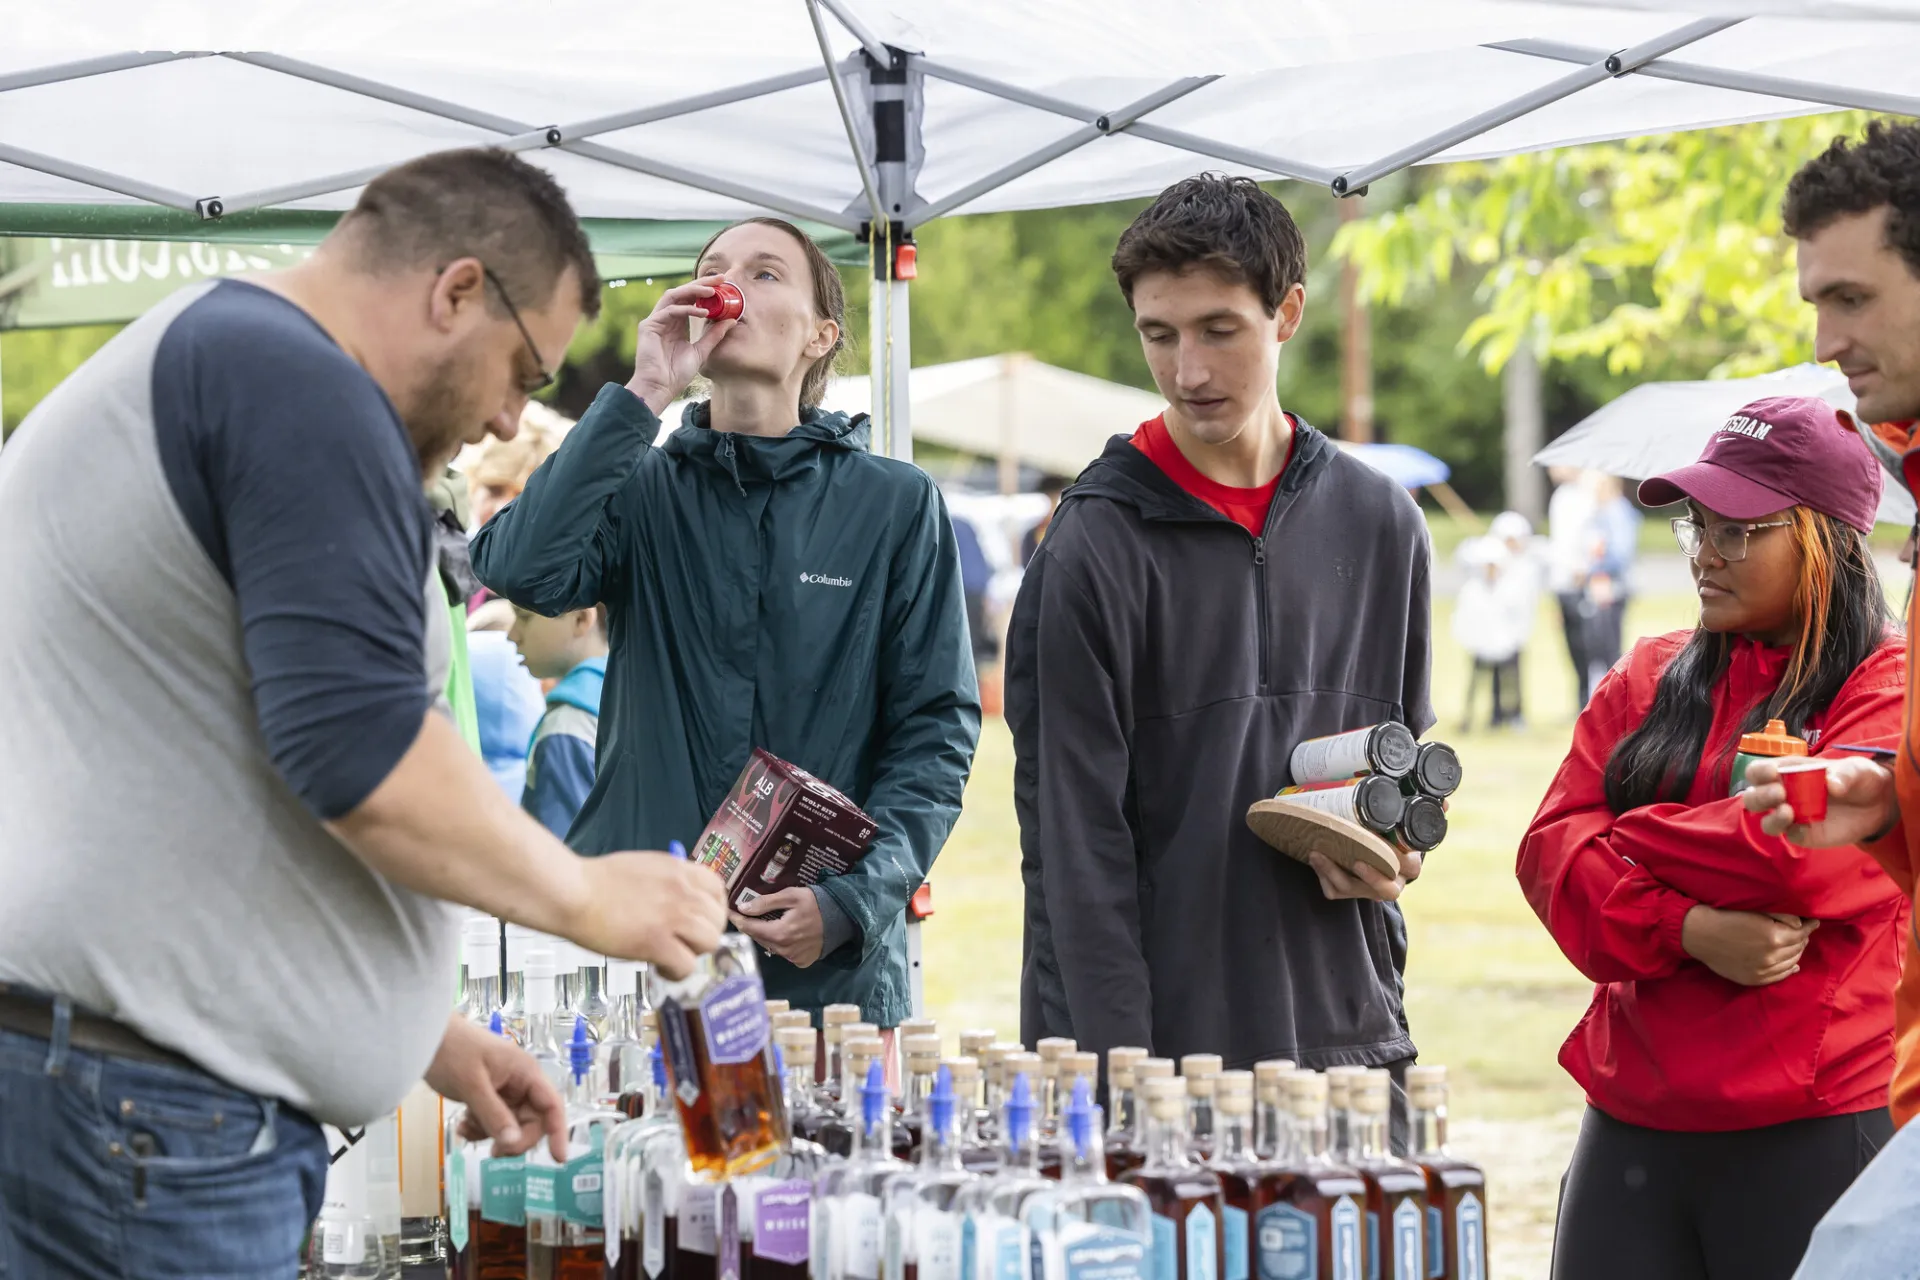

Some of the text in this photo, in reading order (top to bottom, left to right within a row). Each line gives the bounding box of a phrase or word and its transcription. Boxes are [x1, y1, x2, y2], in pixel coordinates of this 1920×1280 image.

[809, 573, 853, 587] Columbia
[755, 776, 774, 796] ALB
[802, 796, 821, 809] WOLF
[822, 806, 837, 818] BITE
